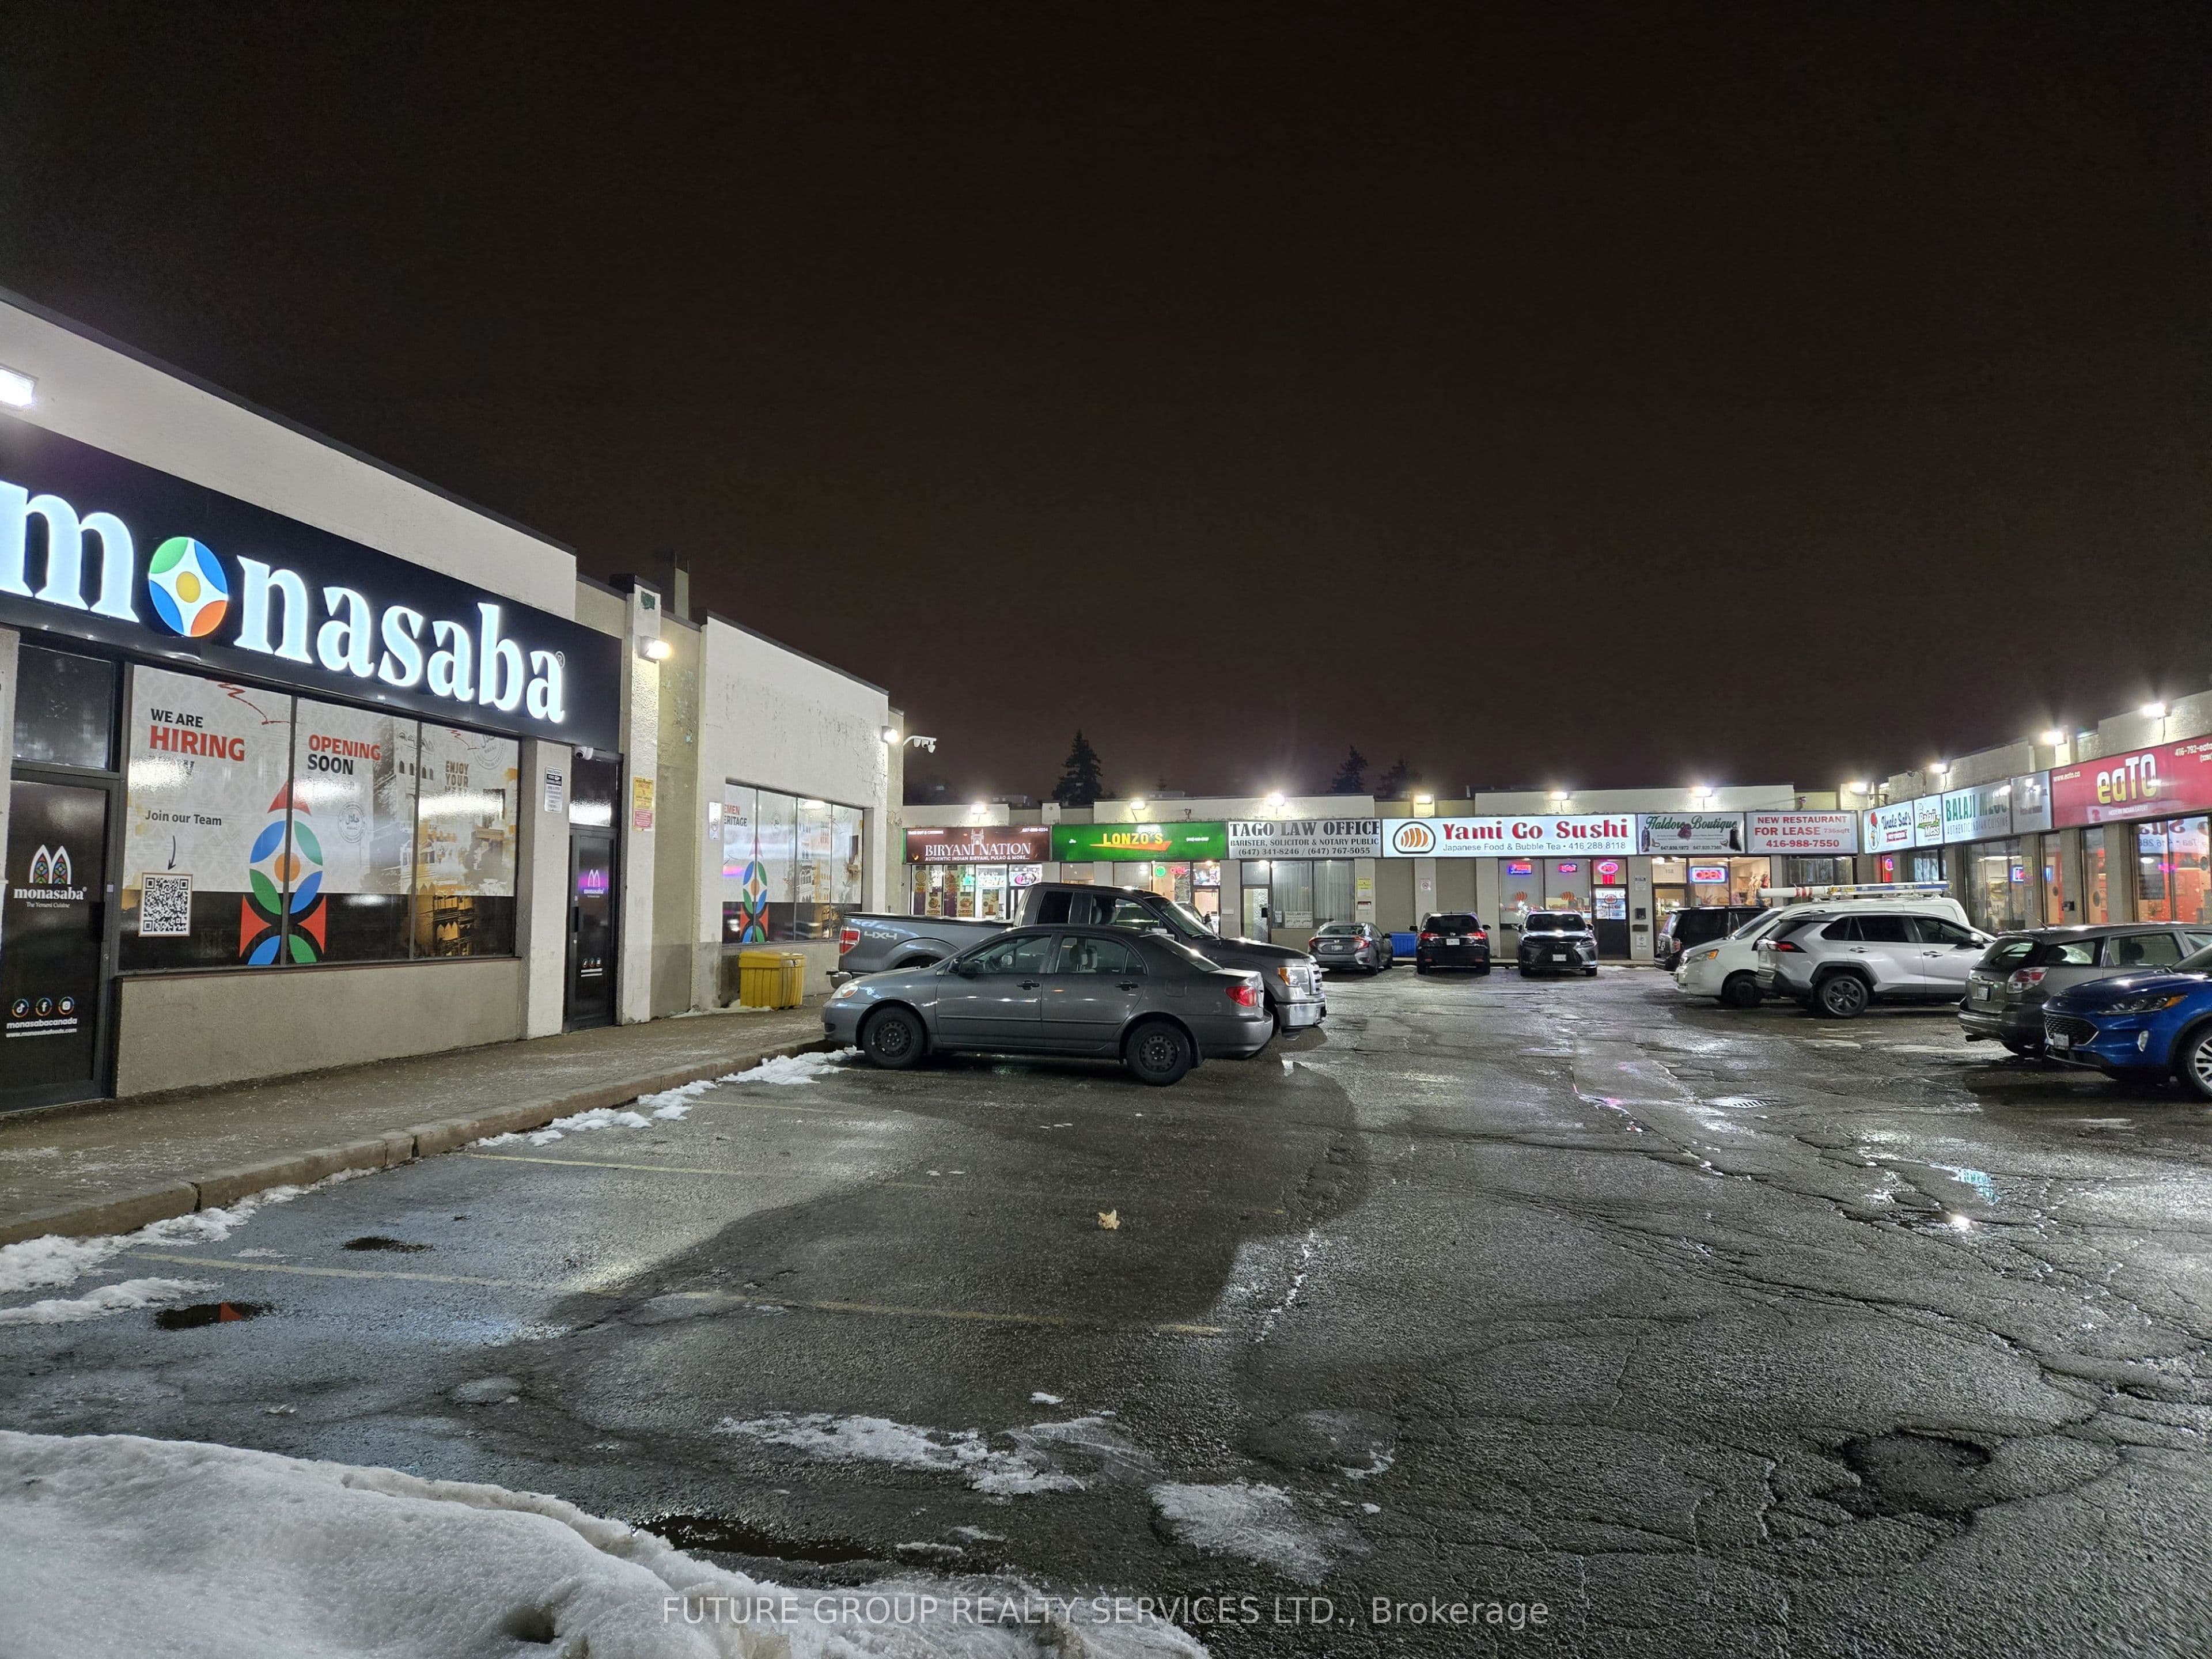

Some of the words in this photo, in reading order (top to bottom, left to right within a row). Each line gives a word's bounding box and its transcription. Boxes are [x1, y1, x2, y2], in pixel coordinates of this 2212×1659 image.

[0, 480, 566, 724] monasaba
[150, 709, 173, 723] WE
[175, 713, 203, 728] ARE
[149, 725, 245, 761] HIRING
[308, 734, 381, 760] OPENING
[308, 754, 354, 775] SOON
[445, 760, 469, 775] ENJOY
[445, 772, 468, 787] YOUR
[724, 804, 740, 815] EMEN
[1945, 794, 1976, 822] BALAJI
[145, 809, 169, 822] Join
[172, 815, 190, 823] our
[194, 813, 222, 826] Team
[724, 815, 747, 827] ERITAGE
[1783, 816, 1847, 824] RESTAURANT
[1881, 813, 1897, 830] Uncle
[1919, 808, 1937, 824] Balaji
[1230, 821, 1275, 836] TAGO
[1280, 821, 1317, 836] LAW
[1323, 821, 1380, 835] OFFICE
[1442, 821, 1503, 840] Yami
[1512, 822, 1543, 840] Go
[1556, 819, 1630, 839] Sushi
[1691, 815, 1737, 833] Boutique
[1755, 827, 1778, 836] FOR
[1782, 827, 1821, 835] LEASE
[1924, 825, 1940, 838] Mess
[1947, 822, 1971, 835] AUTHENTIC
[1103, 833, 1164, 845] LONZO'S
[1442, 843, 1482, 851] Japanese
[1605, 842, 1626, 850] 8118
[1766, 839, 1840, 848] 416-988-7550
[925, 844, 975, 856] BIRYANI
[979, 843, 1032, 855] NATION
[1695, 870, 1722, 880] OPEN
[14, 887, 84, 900] monasaba
[6, 1017, 78, 1029] monasabacanada
